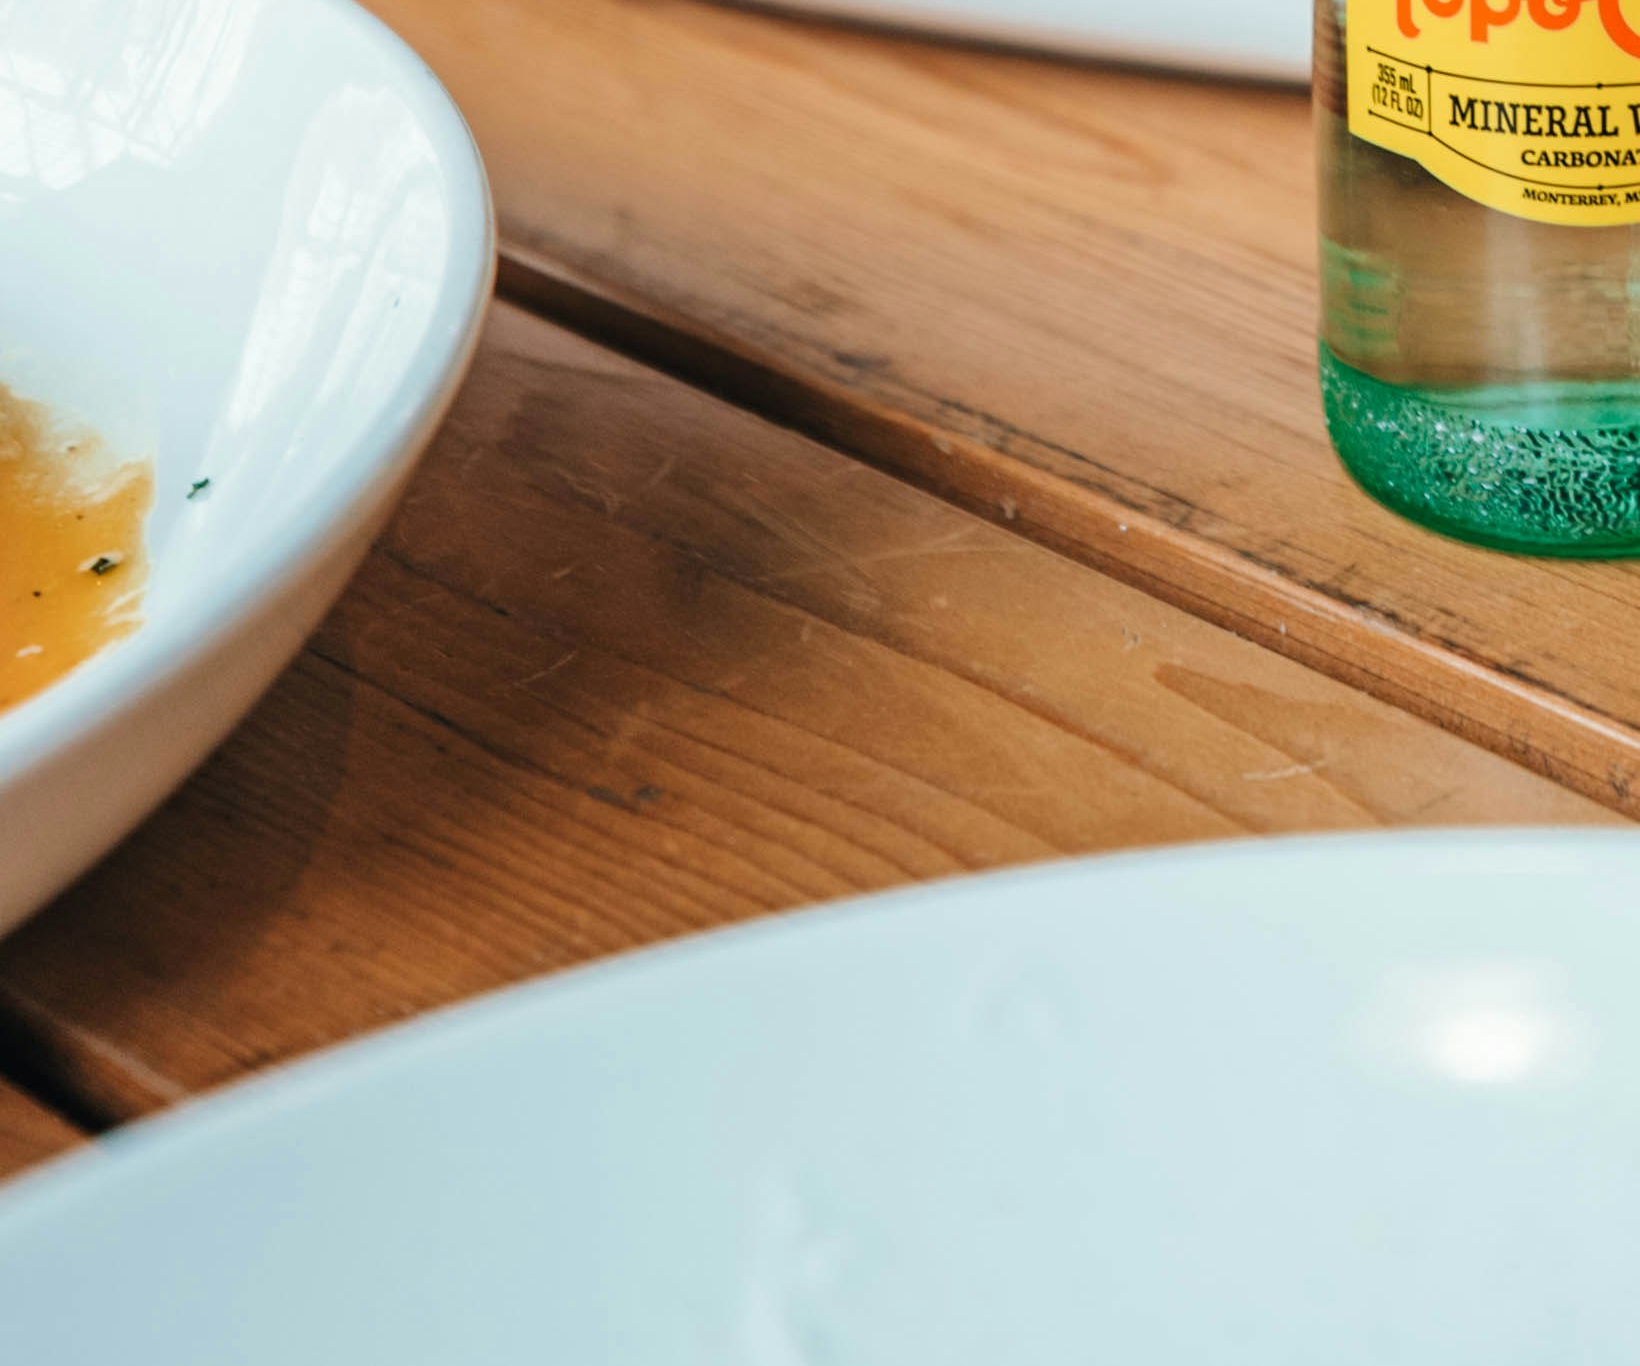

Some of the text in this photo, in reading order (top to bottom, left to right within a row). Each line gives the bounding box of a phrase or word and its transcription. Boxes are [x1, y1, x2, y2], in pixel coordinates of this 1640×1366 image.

[1377, 63, 1417, 95] 355 mL
[1372, 83, 1424, 122] (12 FL OZ)
[1448, 94, 1620, 138] MINERAL
[1521, 187, 1621, 207] MONTERREY,
